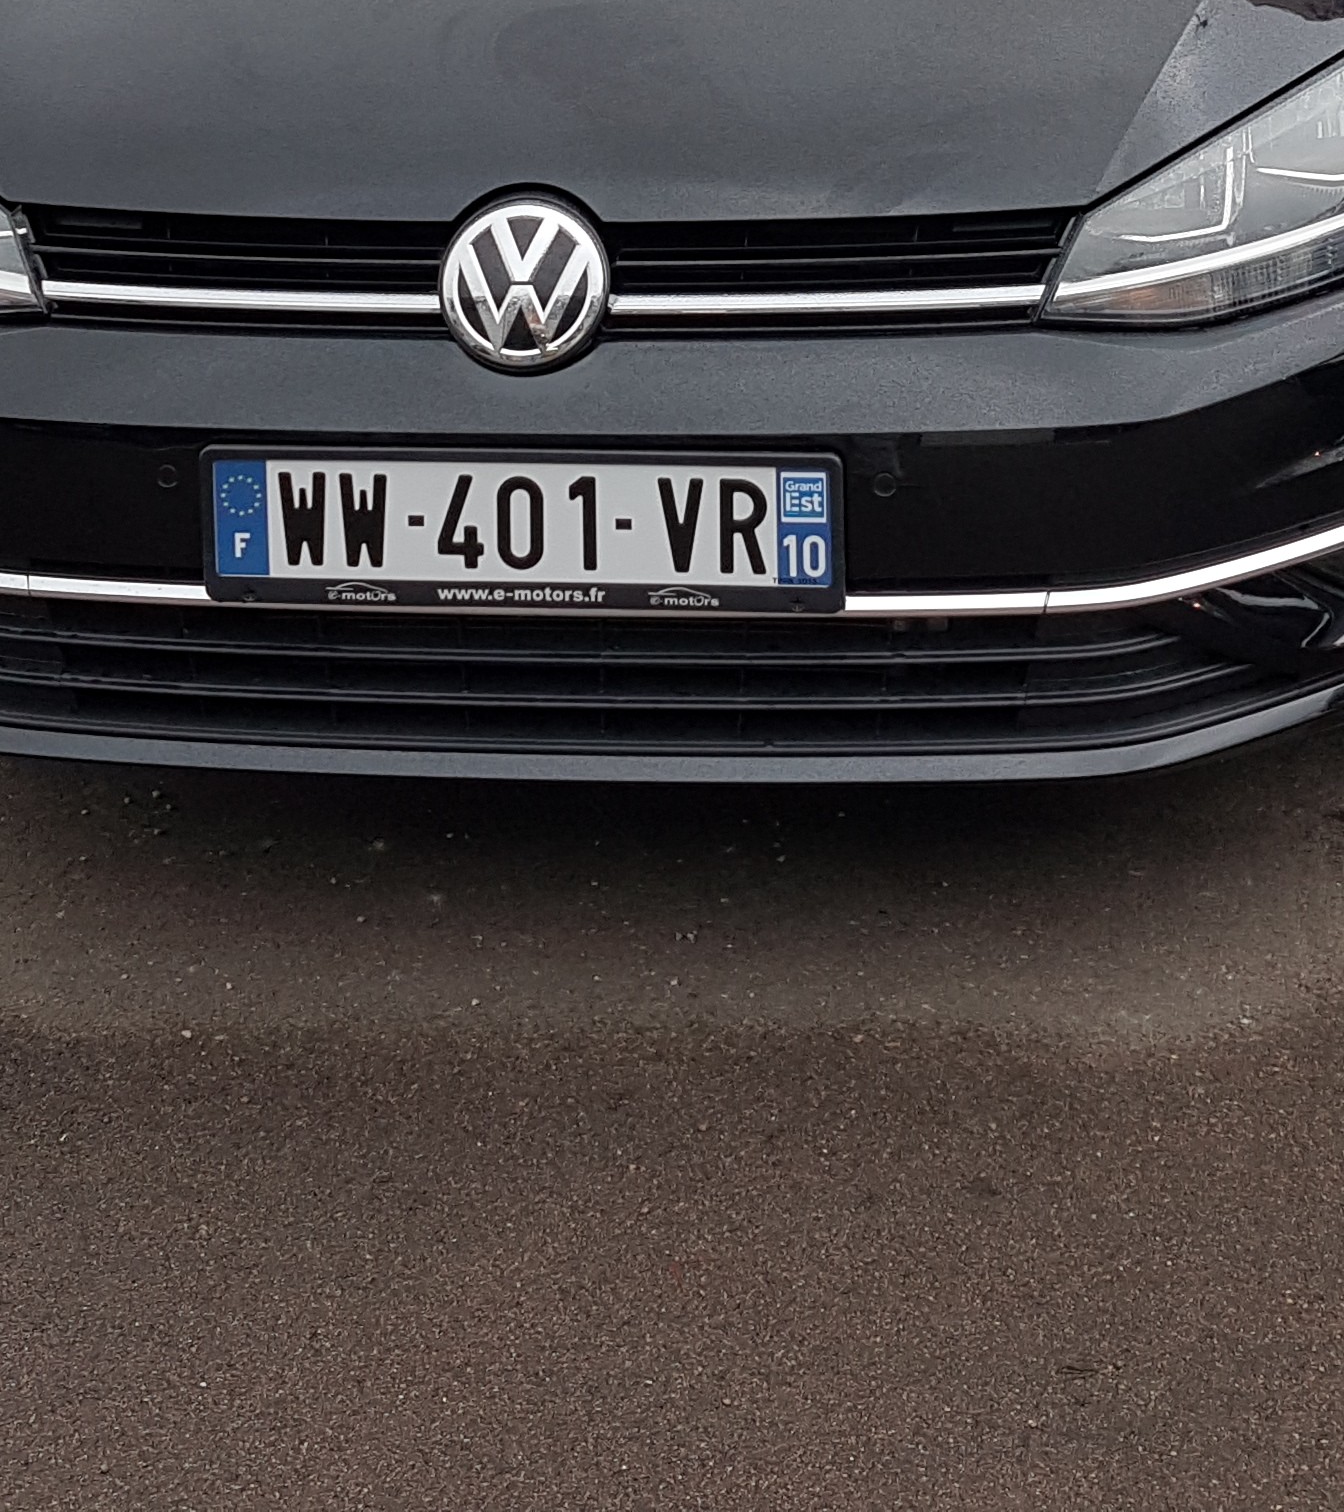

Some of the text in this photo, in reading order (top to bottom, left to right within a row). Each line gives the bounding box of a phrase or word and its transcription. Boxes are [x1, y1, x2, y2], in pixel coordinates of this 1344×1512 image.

[785, 480, 822, 492] Grand
[785, 492, 823, 513] Est
[277, 471, 768, 575] WW-401-VR
[233, 531, 251, 558] F
[782, 534, 826, 578] 10
[436, 587, 606, 603] www.e-motors.fr
